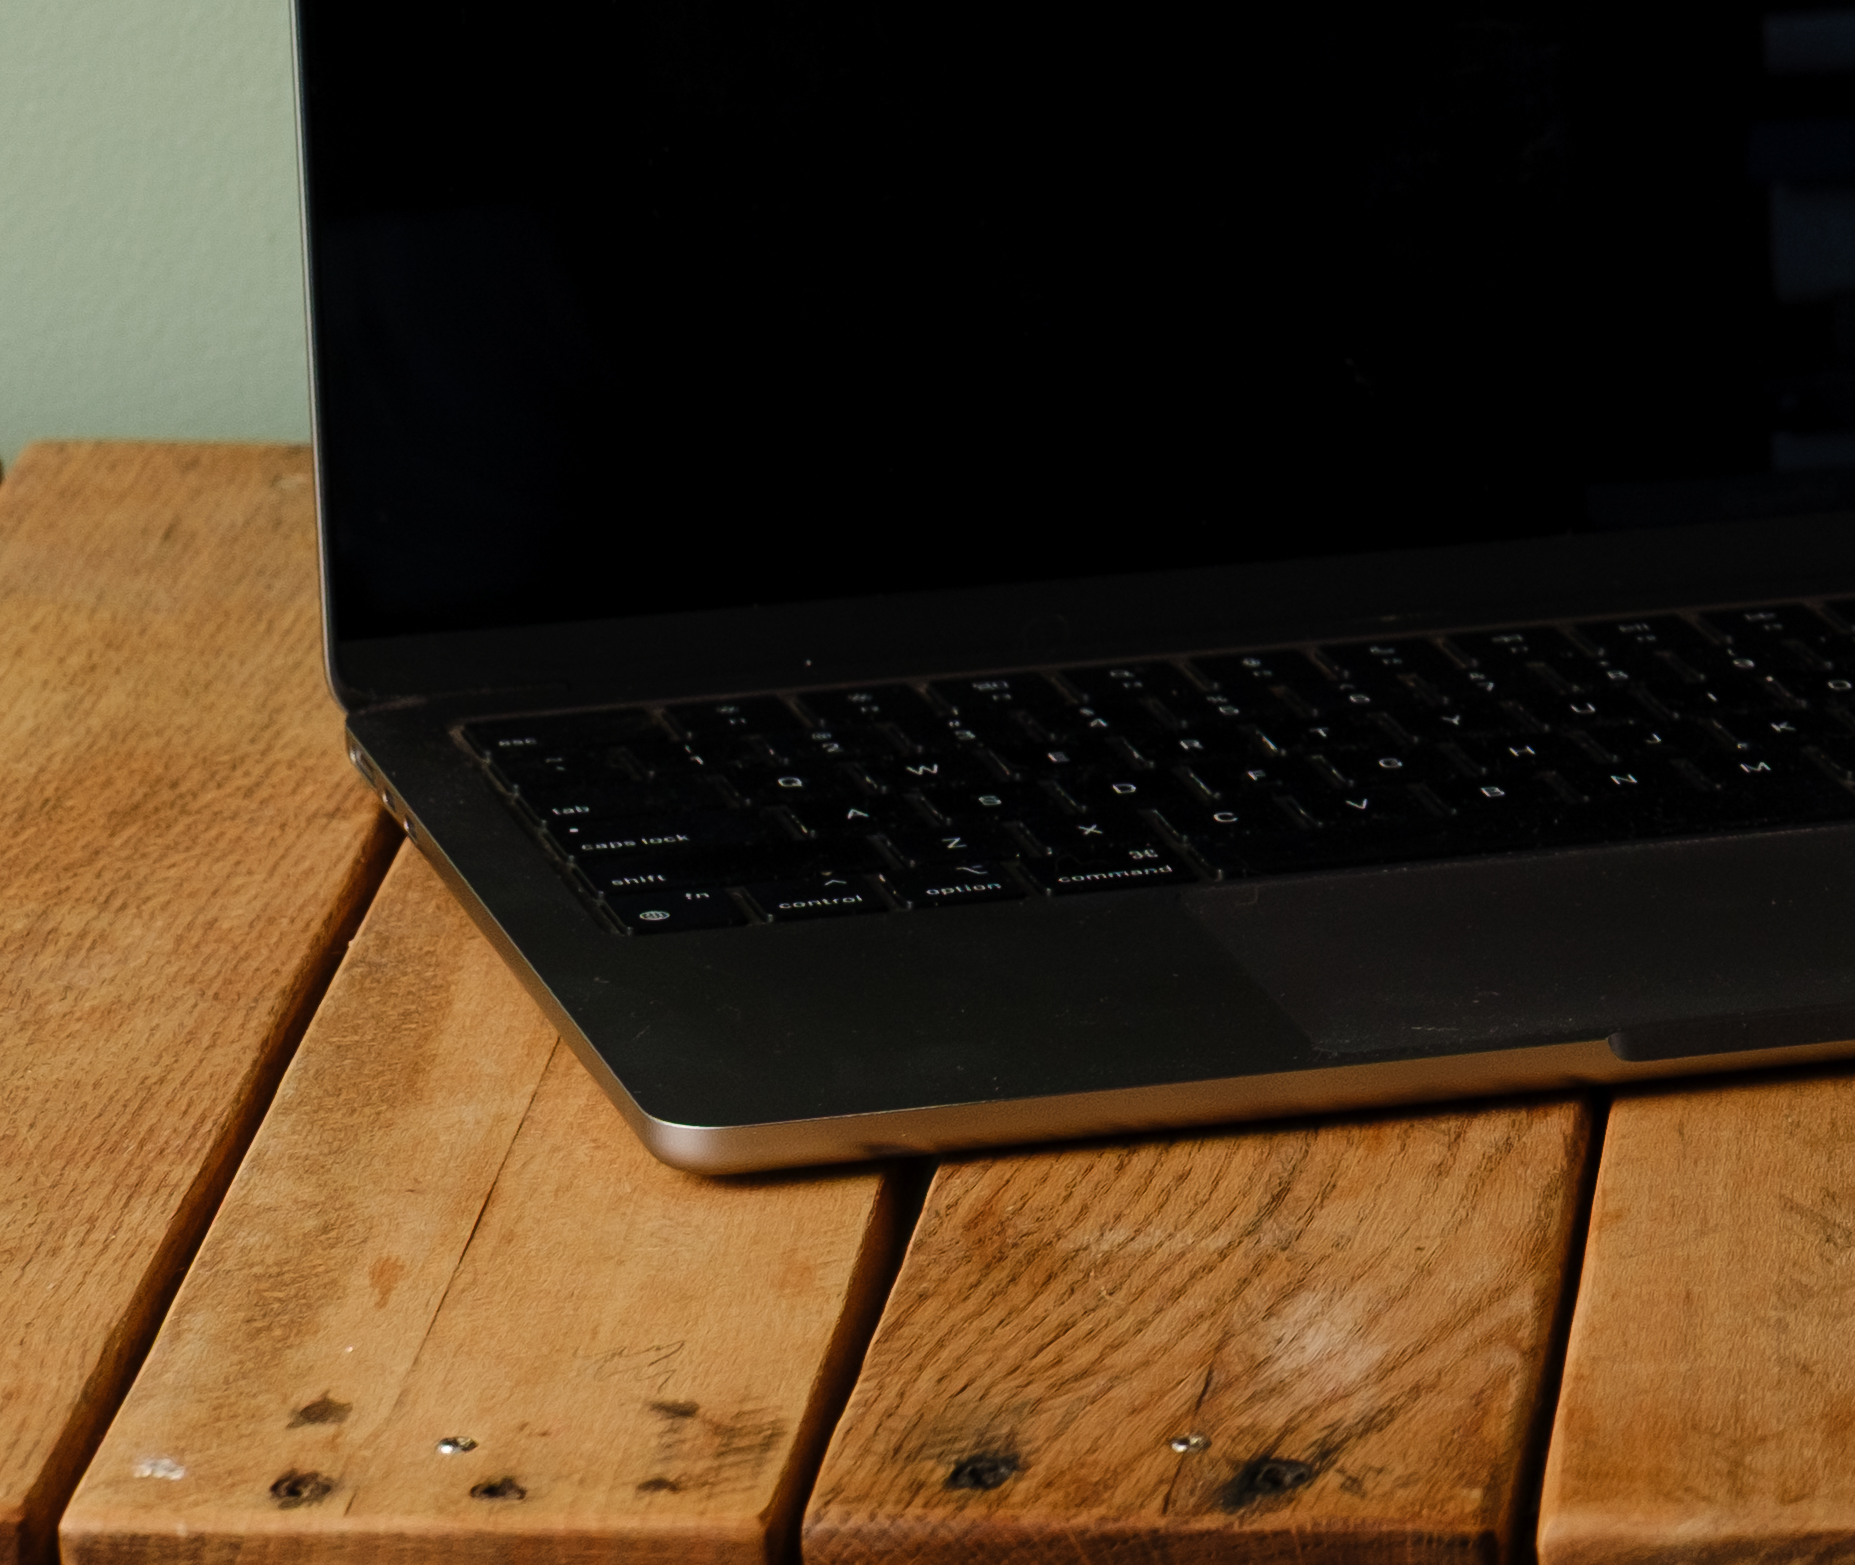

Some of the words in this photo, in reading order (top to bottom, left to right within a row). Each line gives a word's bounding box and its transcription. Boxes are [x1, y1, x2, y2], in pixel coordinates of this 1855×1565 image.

[641, 834, 689, 845] lock
[1058, 865, 1173, 883] command
[926, 883, 1001, 896] option
[778, 894, 863, 909] control
